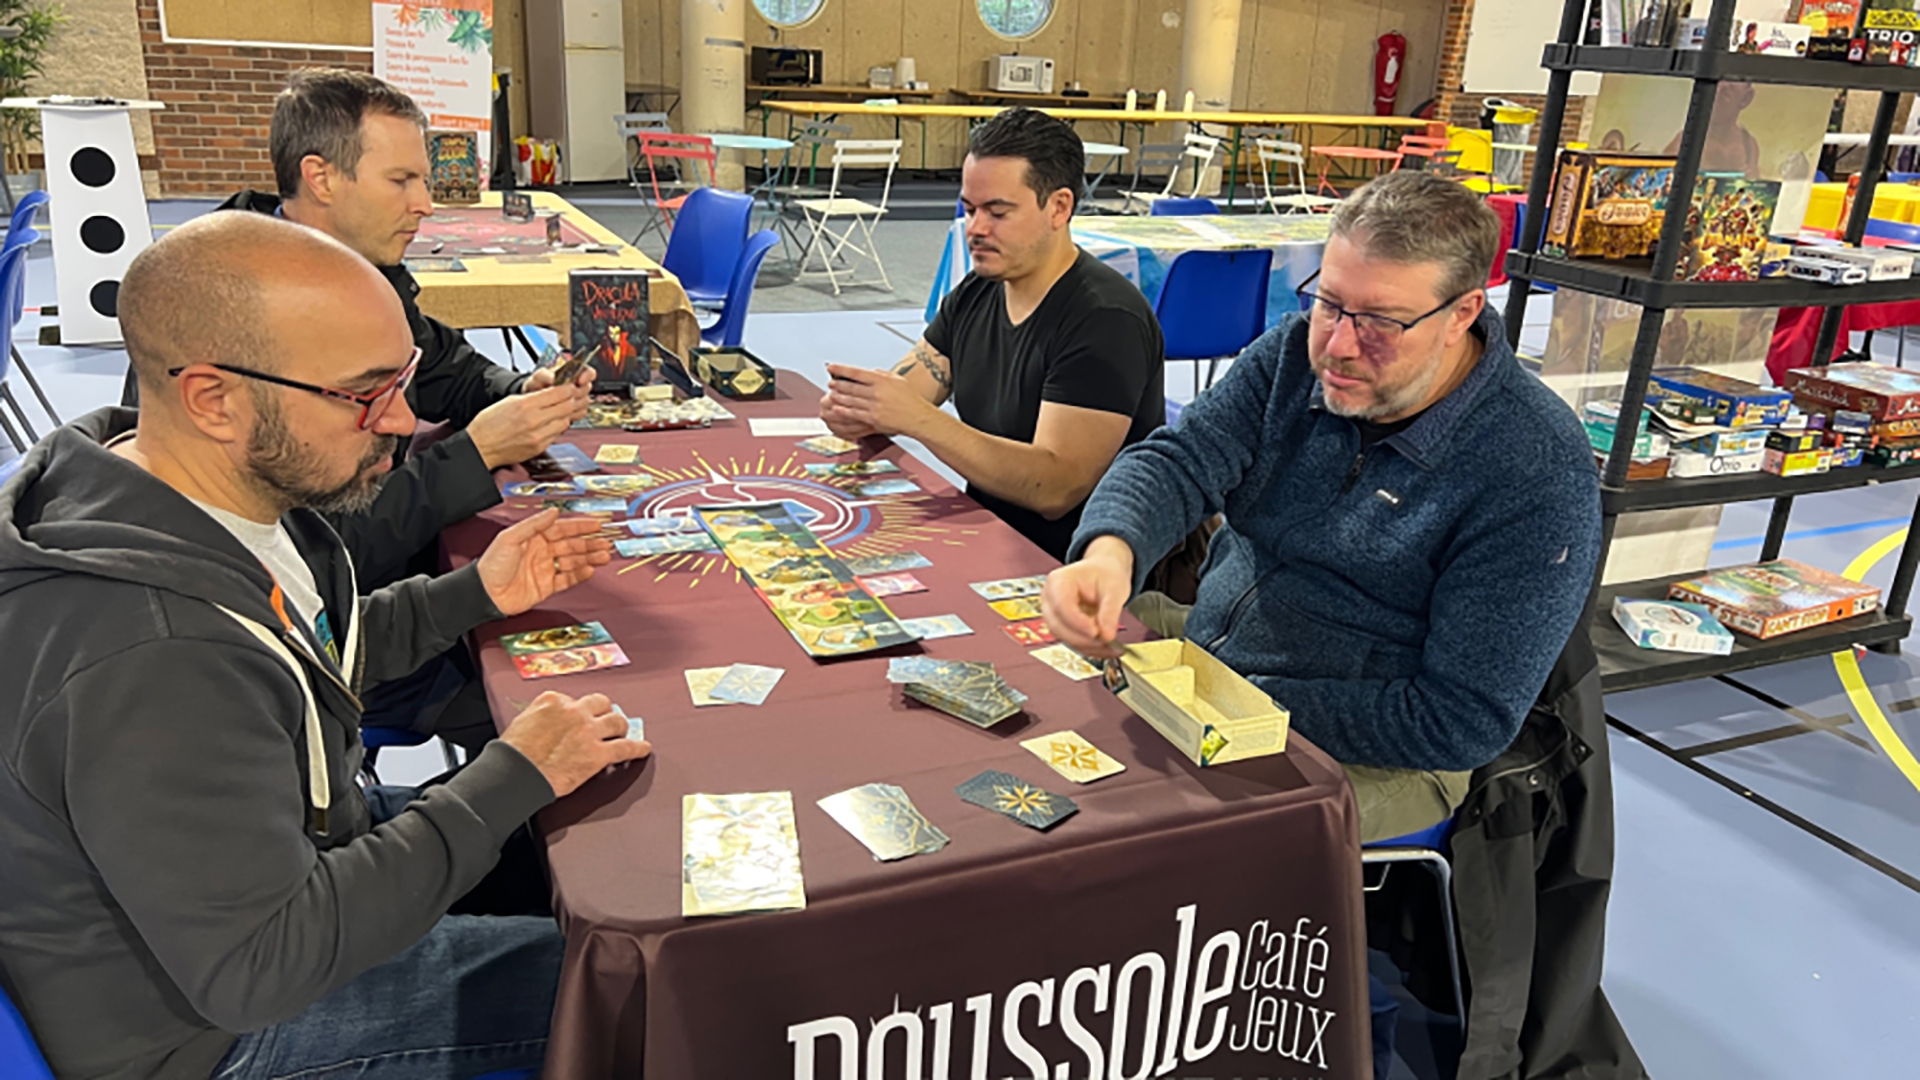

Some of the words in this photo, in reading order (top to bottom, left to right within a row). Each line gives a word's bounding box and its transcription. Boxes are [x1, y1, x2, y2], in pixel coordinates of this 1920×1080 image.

[1867, 29, 1915, 44] TRIO
[1239, 917, 1330, 999] Café
[1230, 989, 1336, 1069] Jeux
